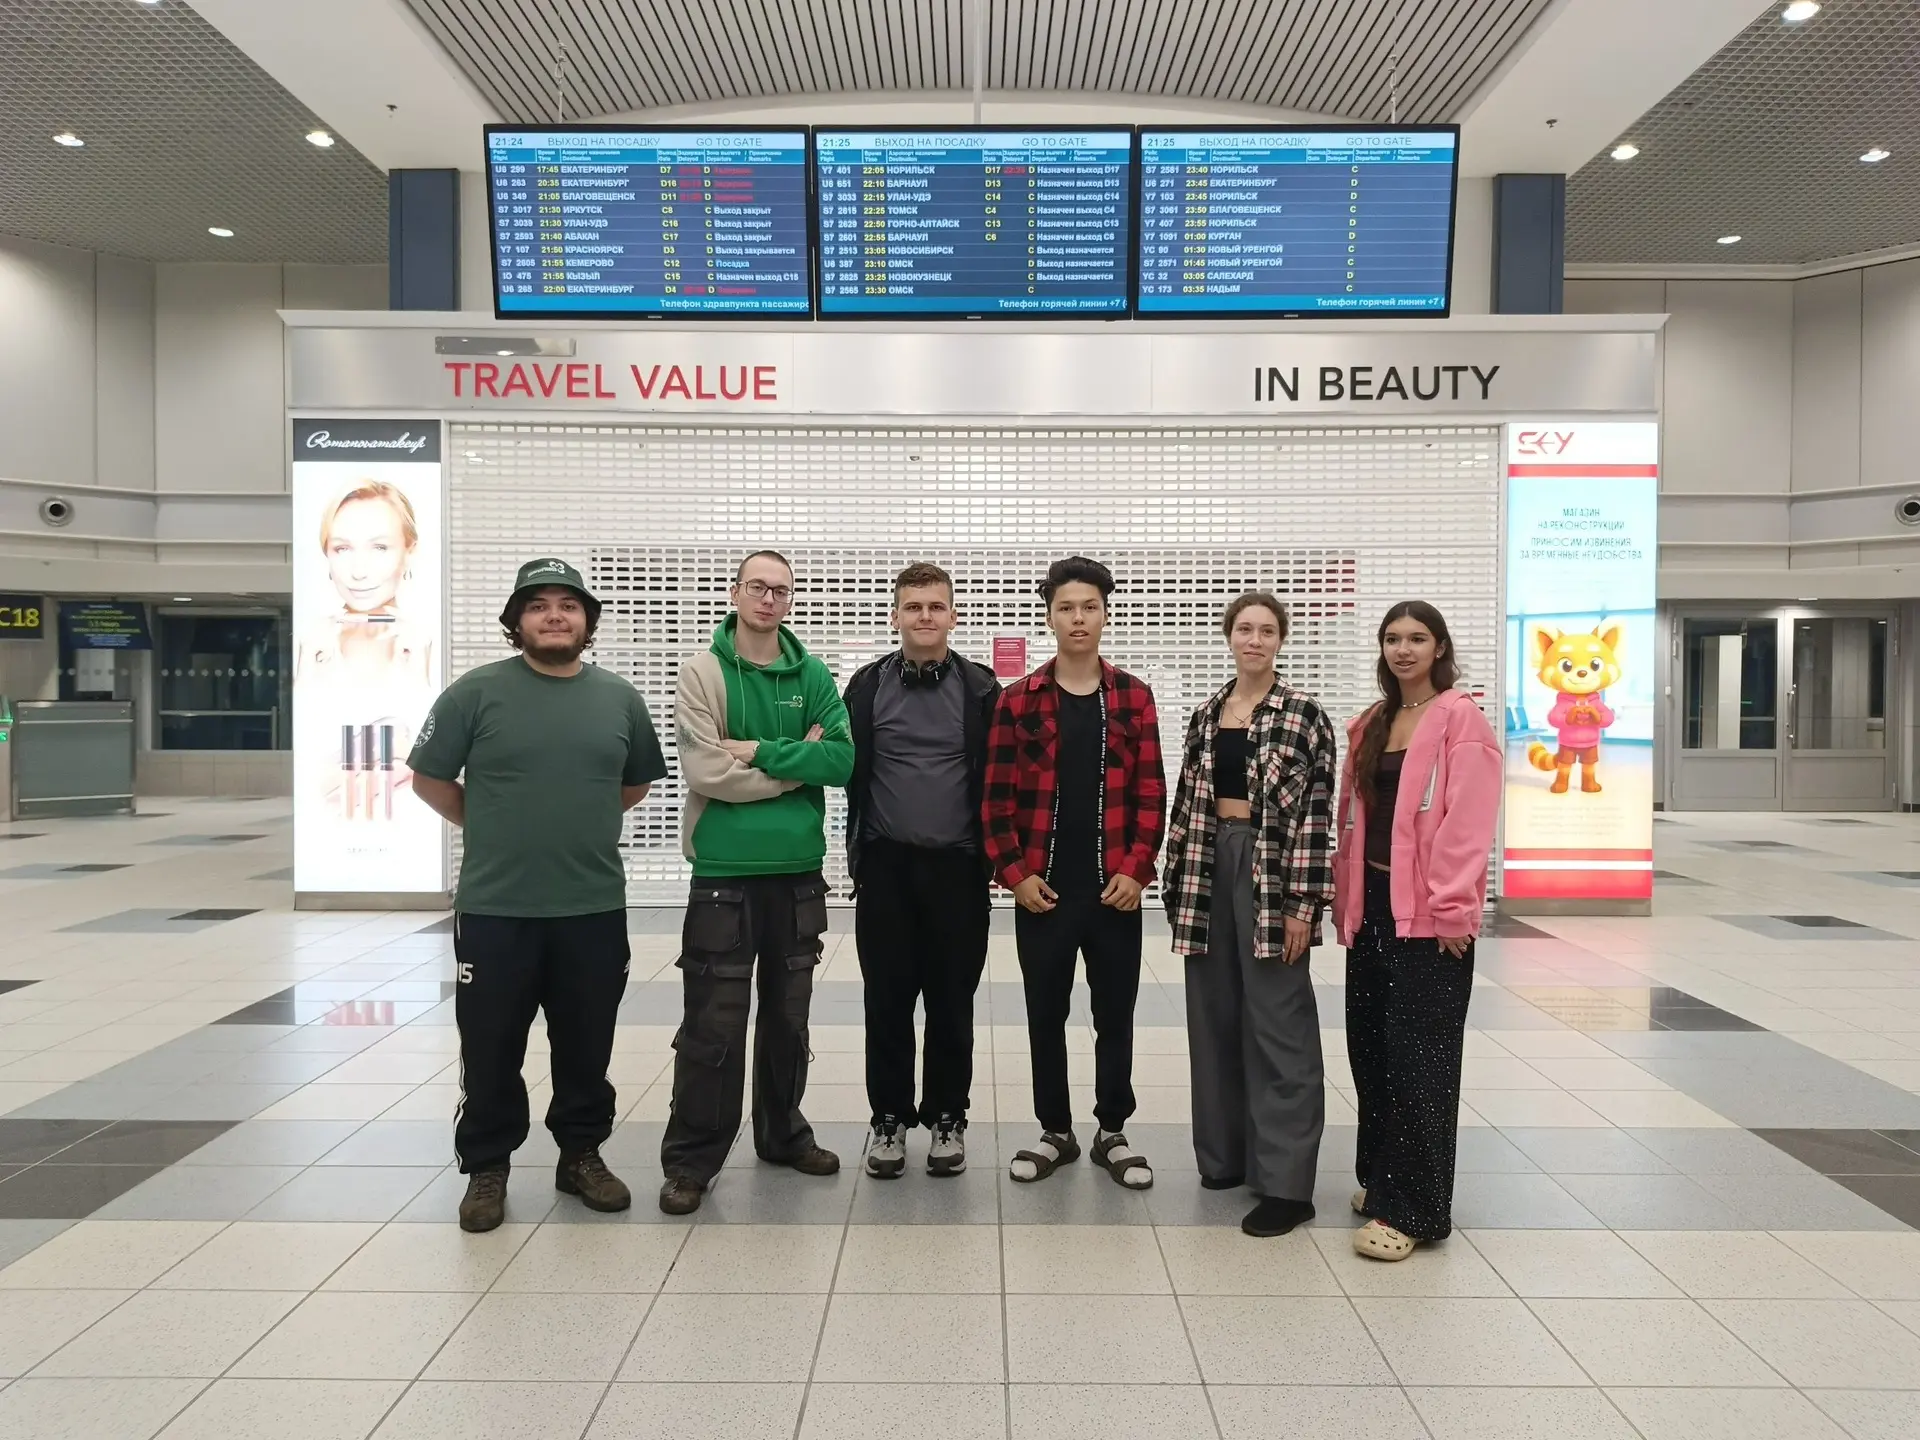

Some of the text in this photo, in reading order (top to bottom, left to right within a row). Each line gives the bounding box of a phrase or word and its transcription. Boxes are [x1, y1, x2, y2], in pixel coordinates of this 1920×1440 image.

[548, 138, 587, 146] ВЫХОД
[609, 138, 660, 146] ПОСАДКУ
[875, 138, 913, 146] ВЫХОД
[917, 138, 931, 146] НА
[935, 138, 986, 146] ПОСАДКУ
[1148, 138, 1175, 146] 21:25
[1200, 138, 1238, 146] ВЫХОД
[1242, 138, 1256, 146] НА
[1259, 138, 1311, 146] ПОСАДКУ
[562, 193, 635, 201] БЛАГОВЕЩЕНСК
[714, 207, 741, 215] Выход
[743, 208, 771, 216] закрыт
[1209, 206, 1281, 214] БЛАГОВЕЩЕНСК
[564, 220, 608, 228] УЛАН-УДЭ
[887, 219, 959, 227] ГОРНО-АЛТАЙСК
[715, 234, 742, 242] Выход
[716, 247, 743, 255] Выход
[1208, 245, 1240, 253] НОВЫЙ
[1243, 245, 1283, 253] УРЕНГОЙ
[1208, 258, 1240, 266] НОВЫЙ
[1242, 258, 1282, 266] УРЕНГОЙ
[660, 300, 700, 309] Телефон
[999, 300, 1038, 309] Телефон
[1041, 300, 1077, 309] горячей
[1316, 299, 1357, 307] Телефон
[1359, 299, 1395, 307] горячей
[444, 362, 778, 401] TRAVEL VALUE
[1255, 366, 1500, 401] IN BEAUTY
[1538, 521, 1624, 530] НА РЕКОНСТРУКЦИИ
[1532, 538, 1631, 546] ПРИНОСИМ ИЗВИНЕНИЯ
[1520, 551, 1642, 560] ЗА ВРЕМЕННЫЕ НЕУДОБСТВА
[0, 608, 39, 627] C18
